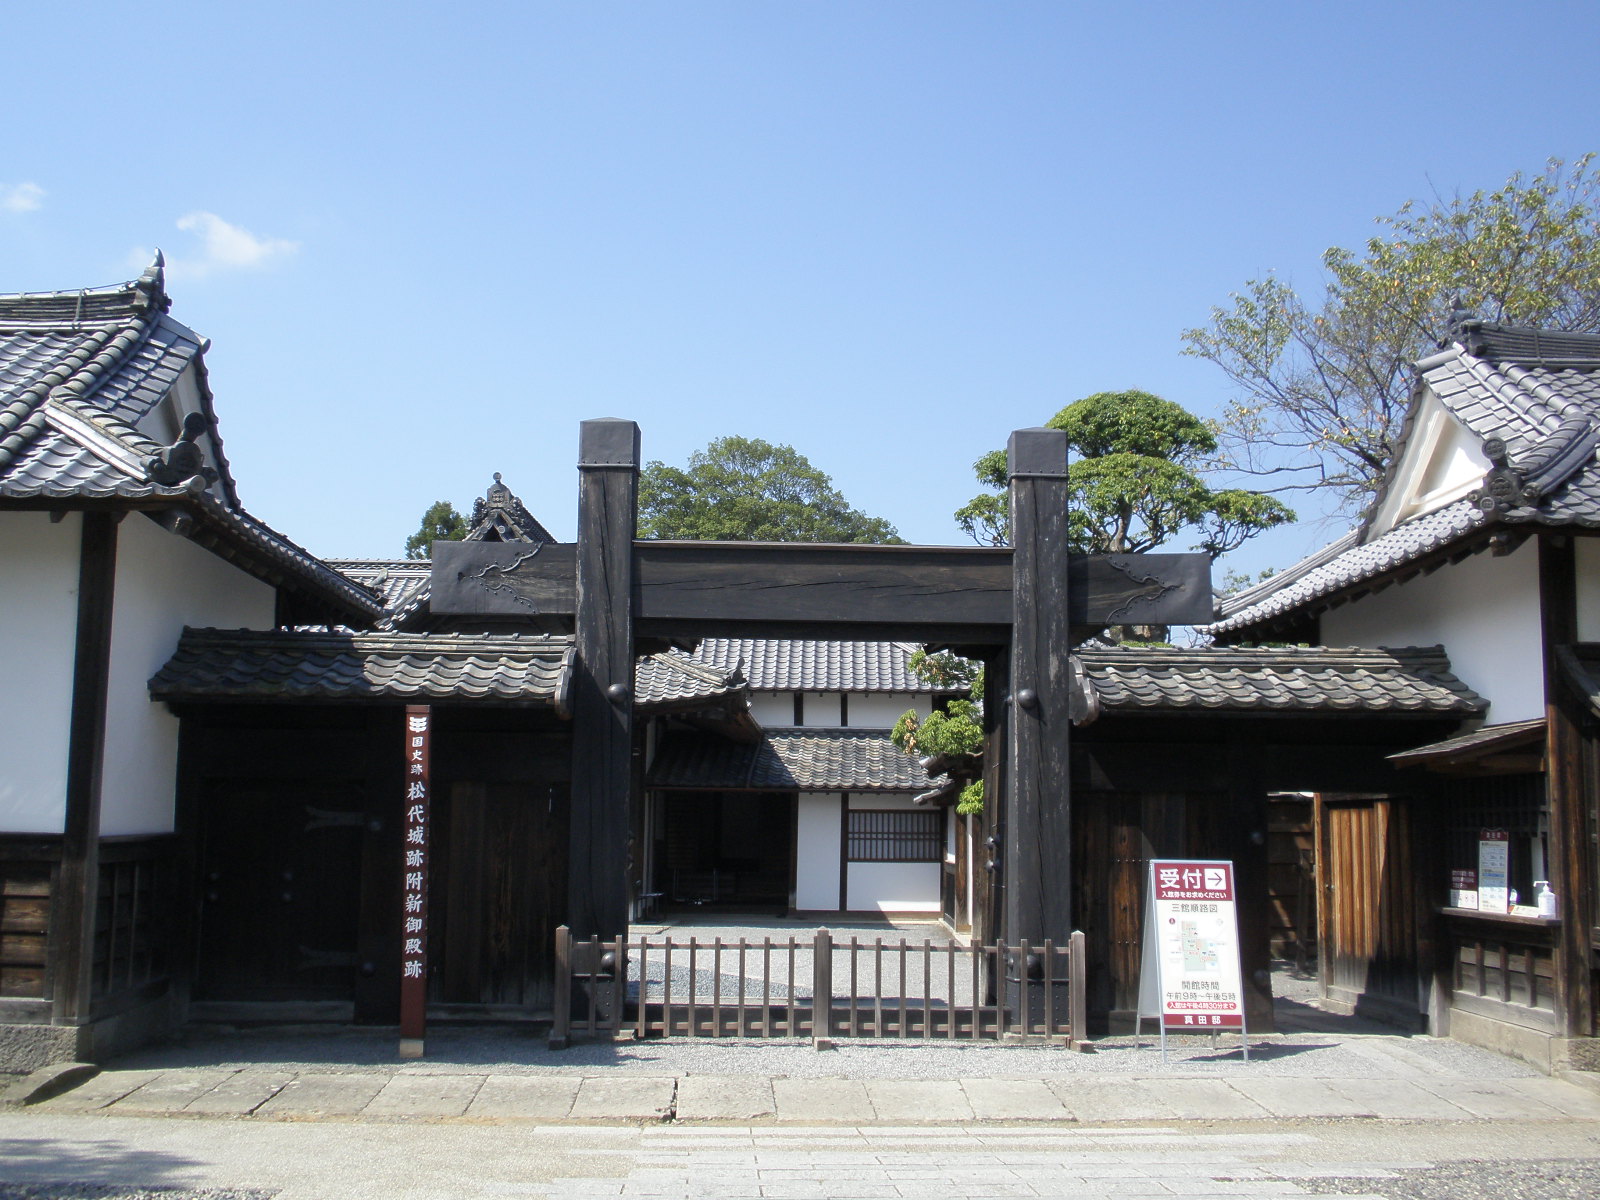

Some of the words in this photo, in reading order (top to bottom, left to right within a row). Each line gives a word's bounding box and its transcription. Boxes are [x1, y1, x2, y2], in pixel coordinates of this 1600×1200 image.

[410, 736, 423, 776] 国史跡
[404, 780, 426, 979] 松代城跡附新御殿跡
[1160, 868, 1202, 889] 受付
[1181, 980, 1220, 991] 開館時間
